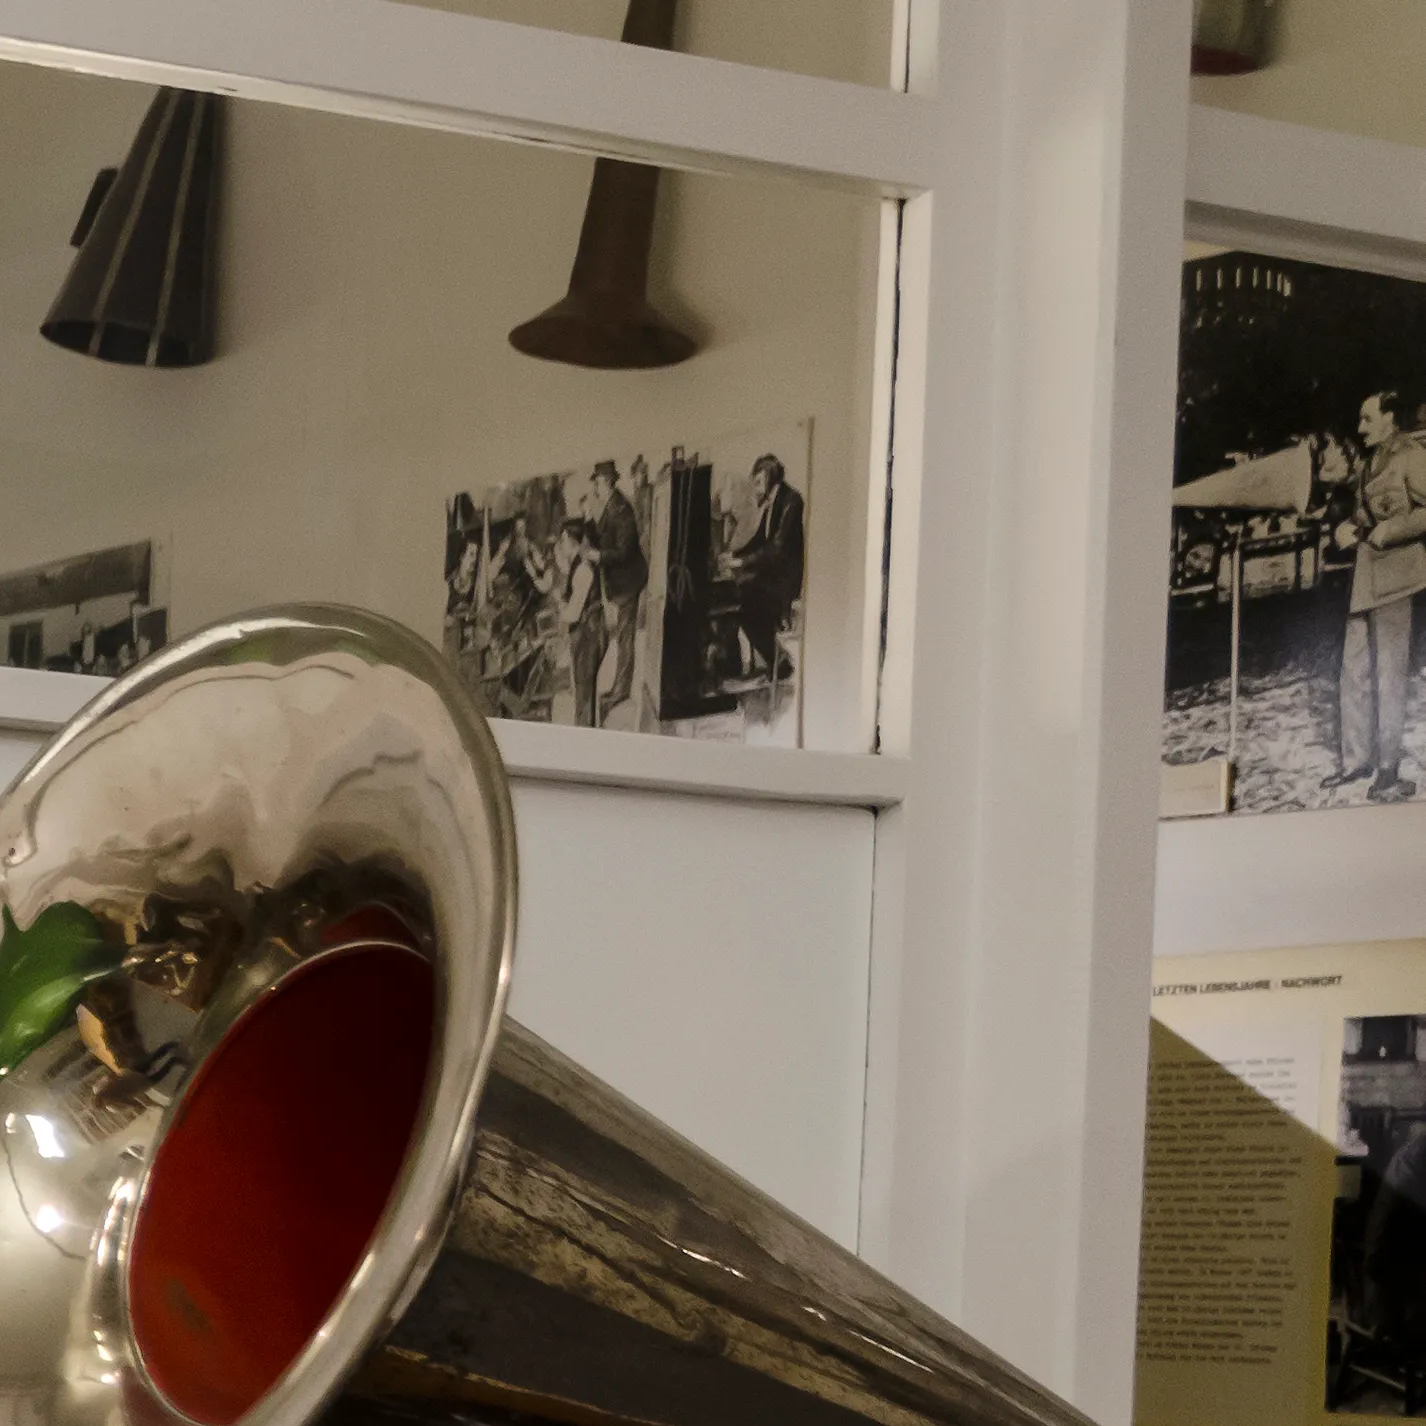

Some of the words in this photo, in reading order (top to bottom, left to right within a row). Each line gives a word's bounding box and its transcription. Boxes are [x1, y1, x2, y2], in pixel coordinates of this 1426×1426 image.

[1153, 983, 1198, 997] LETZTEN
[1199, 979, 1270, 994] LEBENSJAHRE
[1281, 974, 1343, 989] NACHWORT
